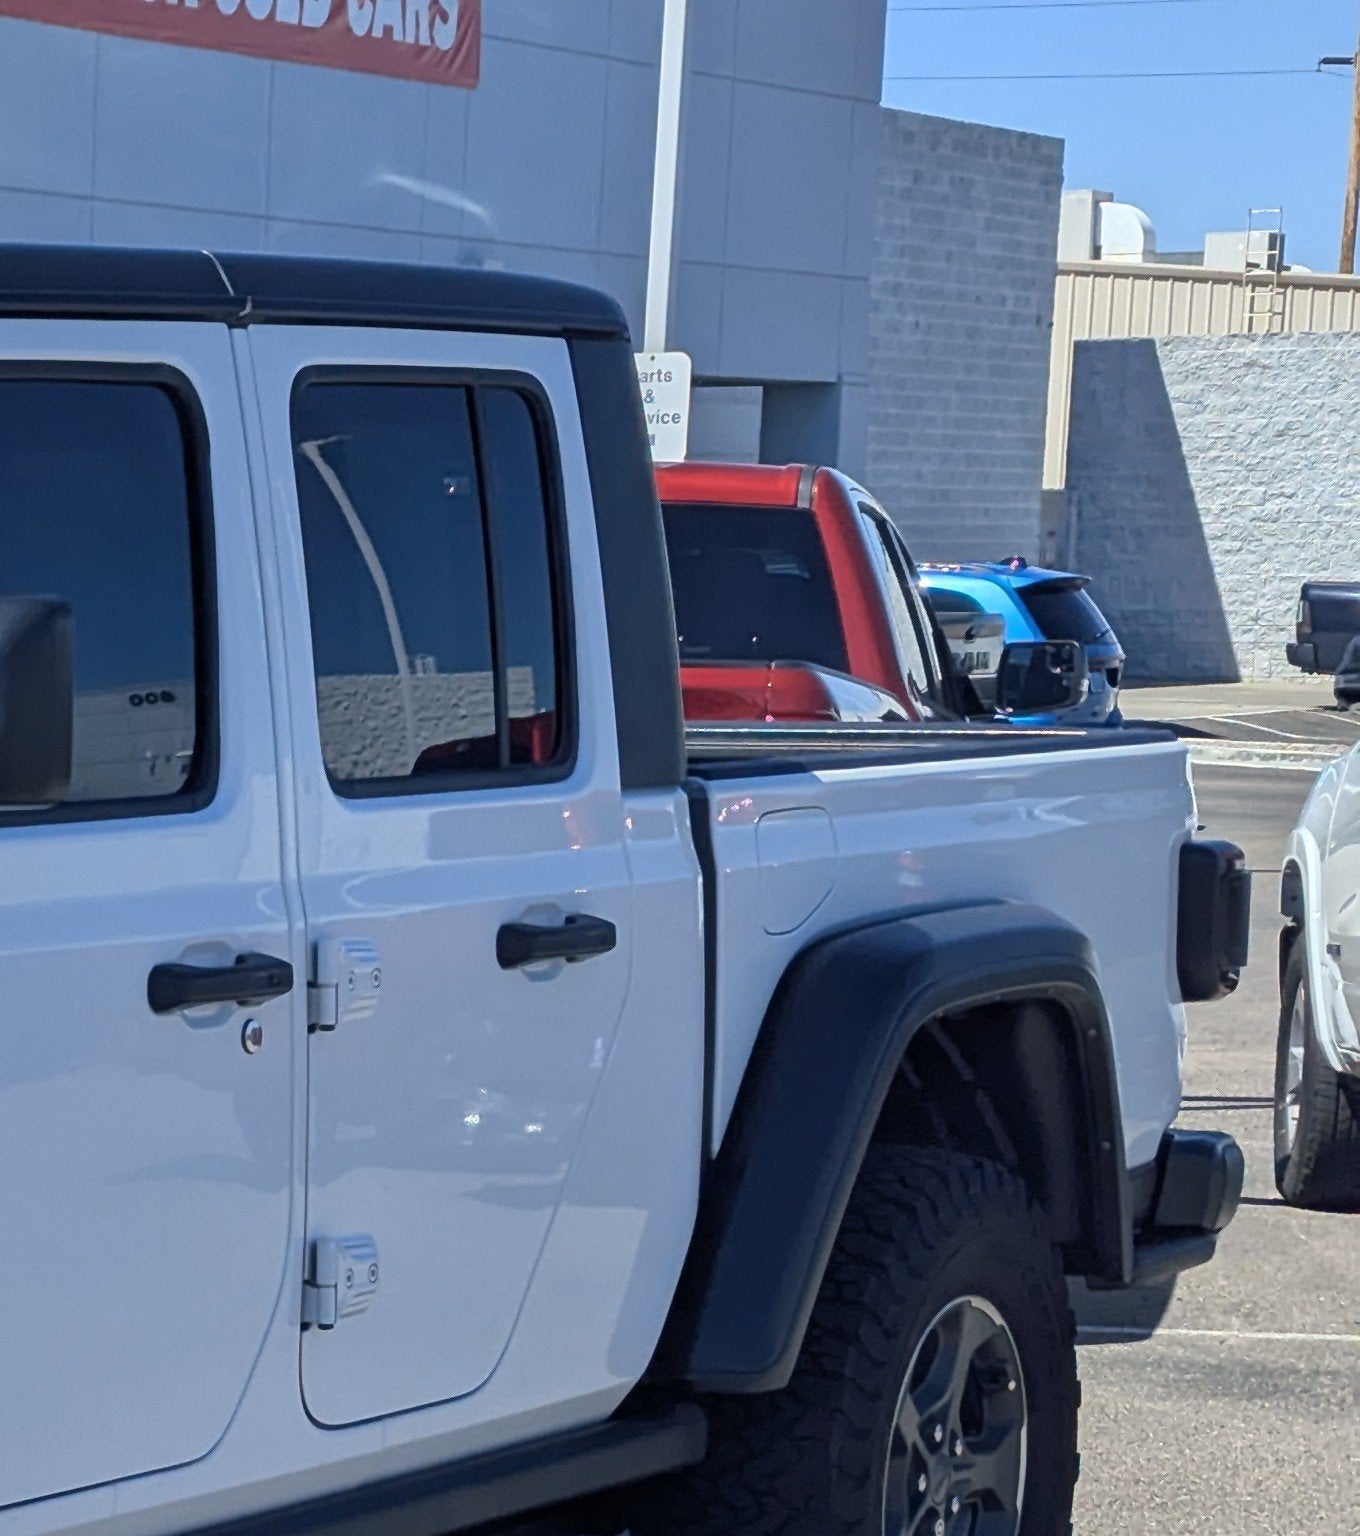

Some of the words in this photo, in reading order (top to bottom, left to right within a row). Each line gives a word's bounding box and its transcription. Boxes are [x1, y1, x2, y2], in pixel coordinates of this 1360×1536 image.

[638, 369, 673, 383] arts
[644, 389, 656, 403] &
[646, 410, 681, 425] vice
